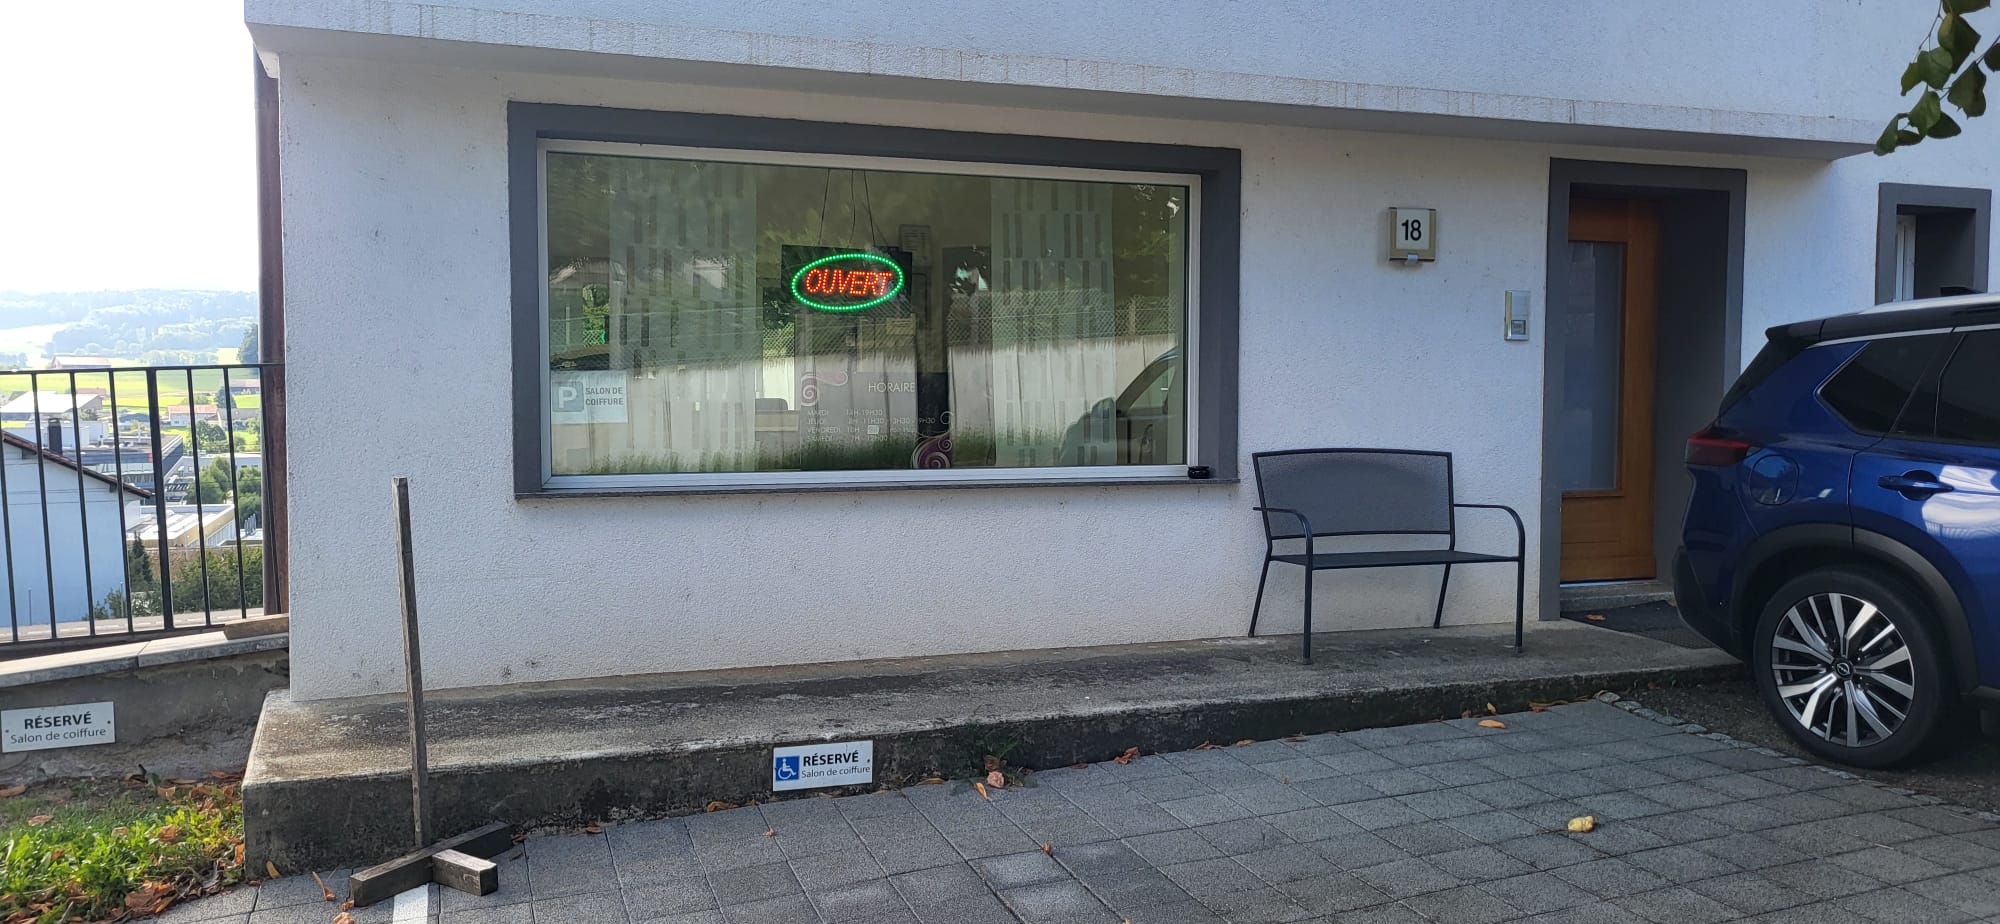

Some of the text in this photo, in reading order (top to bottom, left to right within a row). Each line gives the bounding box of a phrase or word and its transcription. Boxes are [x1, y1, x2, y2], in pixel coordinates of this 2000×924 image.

[1401, 219, 1422, 241] 18
[805, 268, 893, 296] OUVERT
[585, 387, 624, 395] SALON DE
[868, 382, 916, 393] HORAIRE
[558, 386, 578, 408] P
[585, 398, 625, 406] COIFFURE
[24, 711, 93, 730] RÉSERVÉ
[10, 727, 107, 744] Salon de coiffure
[803, 750, 860, 767] RÉSERVÉ
[801, 765, 871, 778] Salon de coiffure
